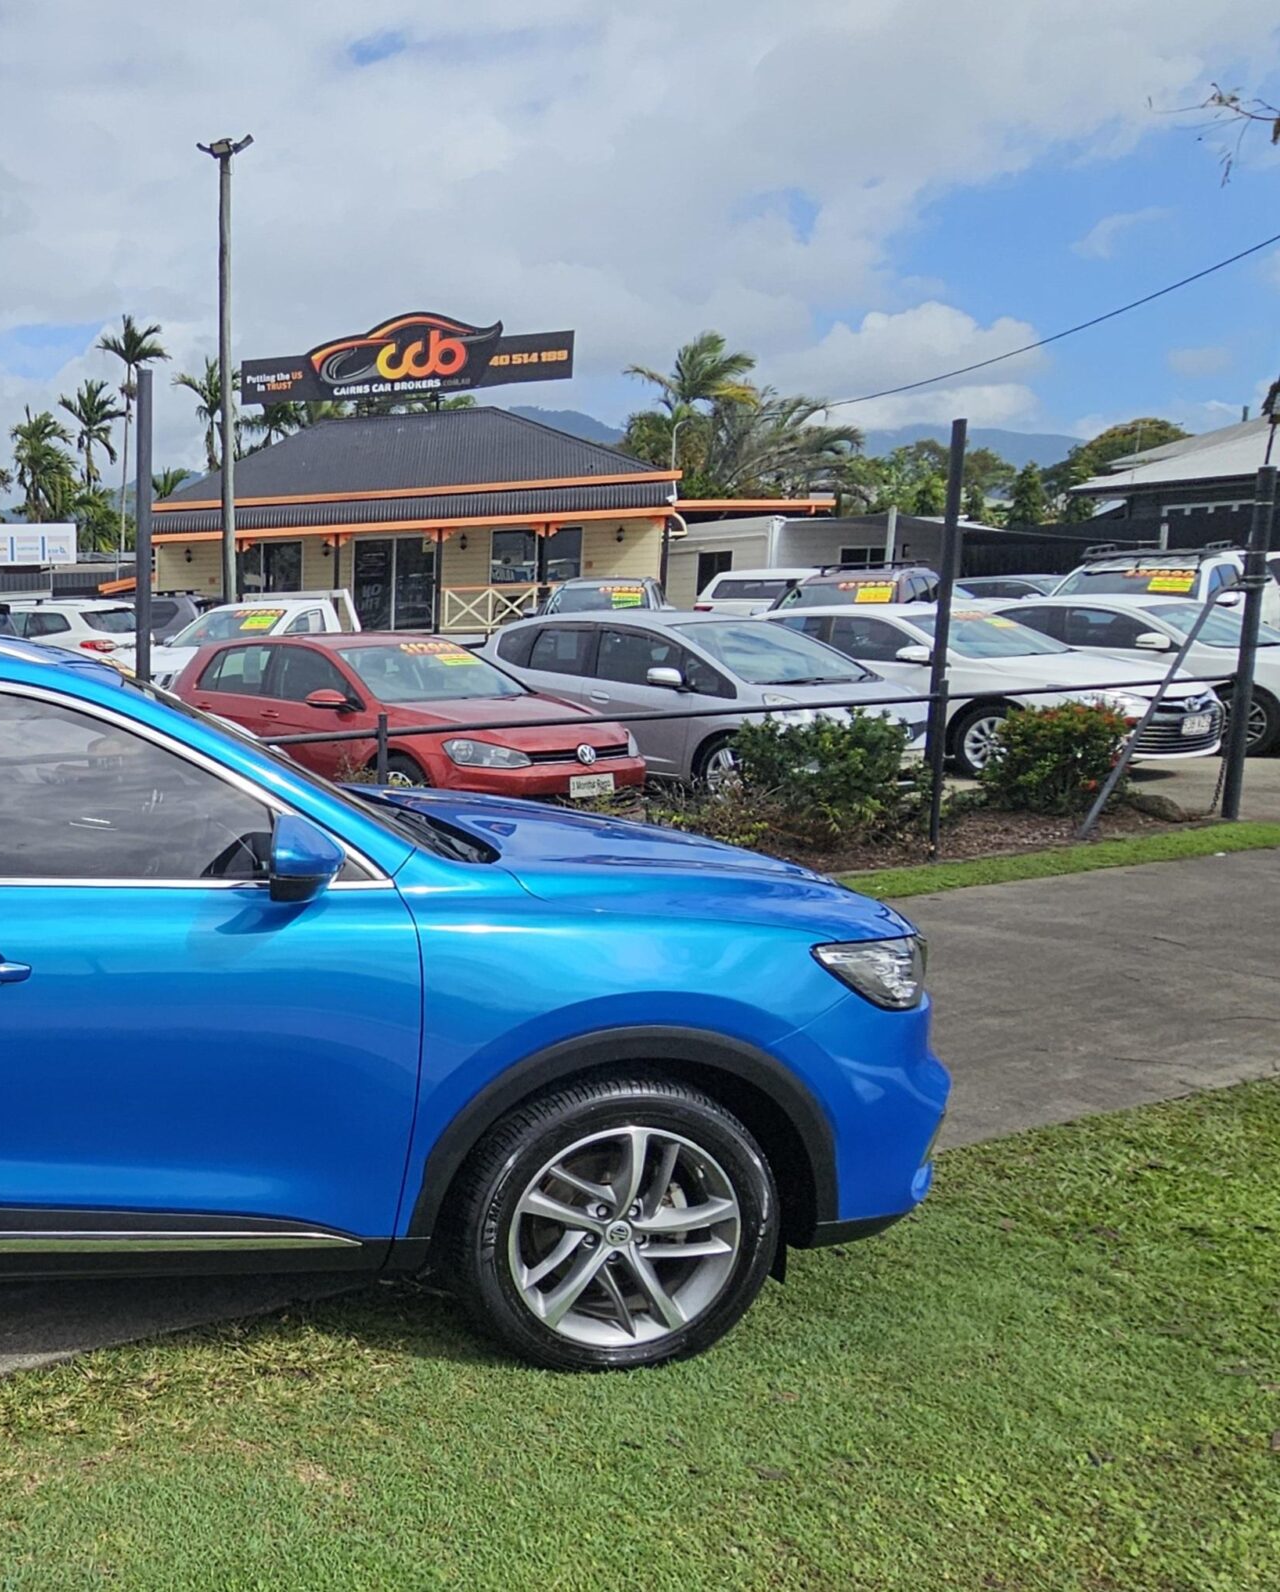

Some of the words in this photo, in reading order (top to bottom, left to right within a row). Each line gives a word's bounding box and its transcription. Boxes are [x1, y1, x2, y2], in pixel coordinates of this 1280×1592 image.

[489, 354, 510, 366] 40
[512, 352, 538, 364] 514
[277, 372, 290, 381] the
[266, 381, 293, 391] TRUST
[333, 384, 370, 396] CAIRNS
[372, 382, 392, 393] CAR
